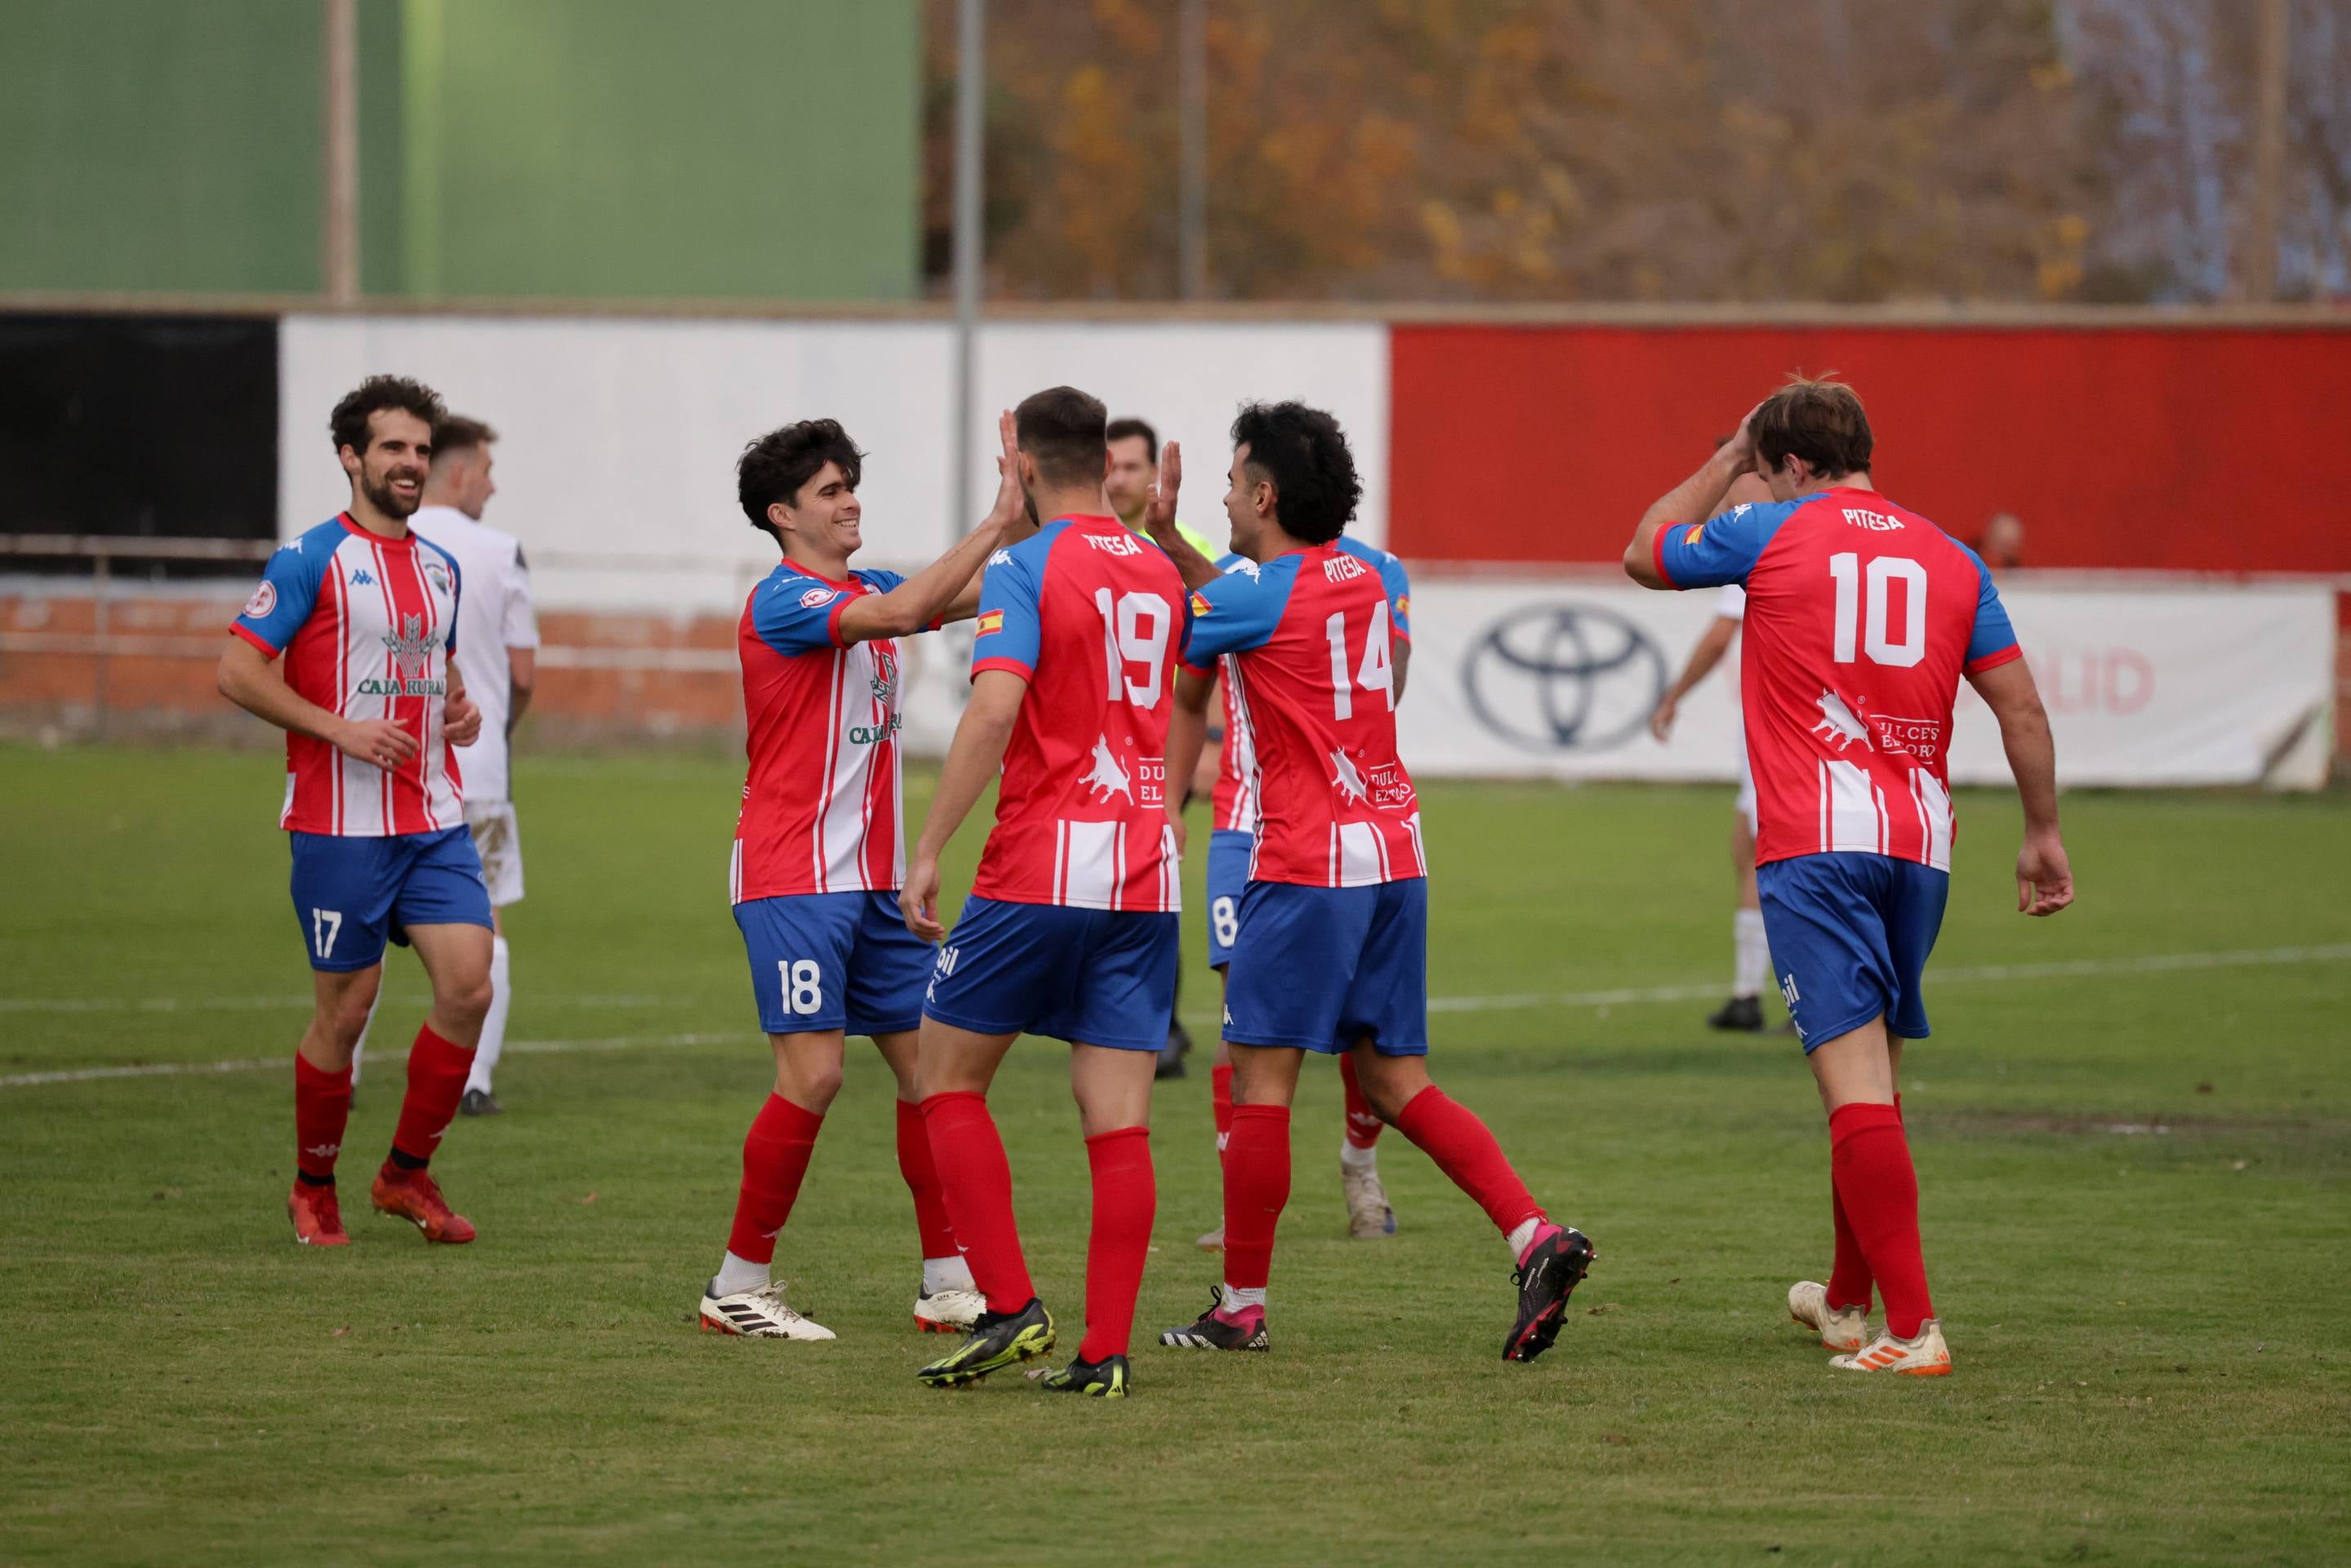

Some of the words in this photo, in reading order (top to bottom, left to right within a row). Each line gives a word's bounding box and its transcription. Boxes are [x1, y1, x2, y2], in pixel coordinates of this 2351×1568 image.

[1841, 509, 1905, 531] PITESA
[1323, 555, 1366, 583] PITESA
[1829, 552, 1927, 668] 10
[1094, 587, 1171, 710] 19
[1326, 599, 1395, 720] 14
[358, 679, 401, 695] CAJA
[1875, 722, 1939, 741] ULCES
[1140, 785, 1163, 800] EL
[314, 908, 341, 958] 17
[1213, 896, 1239, 947] 8
[778, 960, 822, 1014] 18
